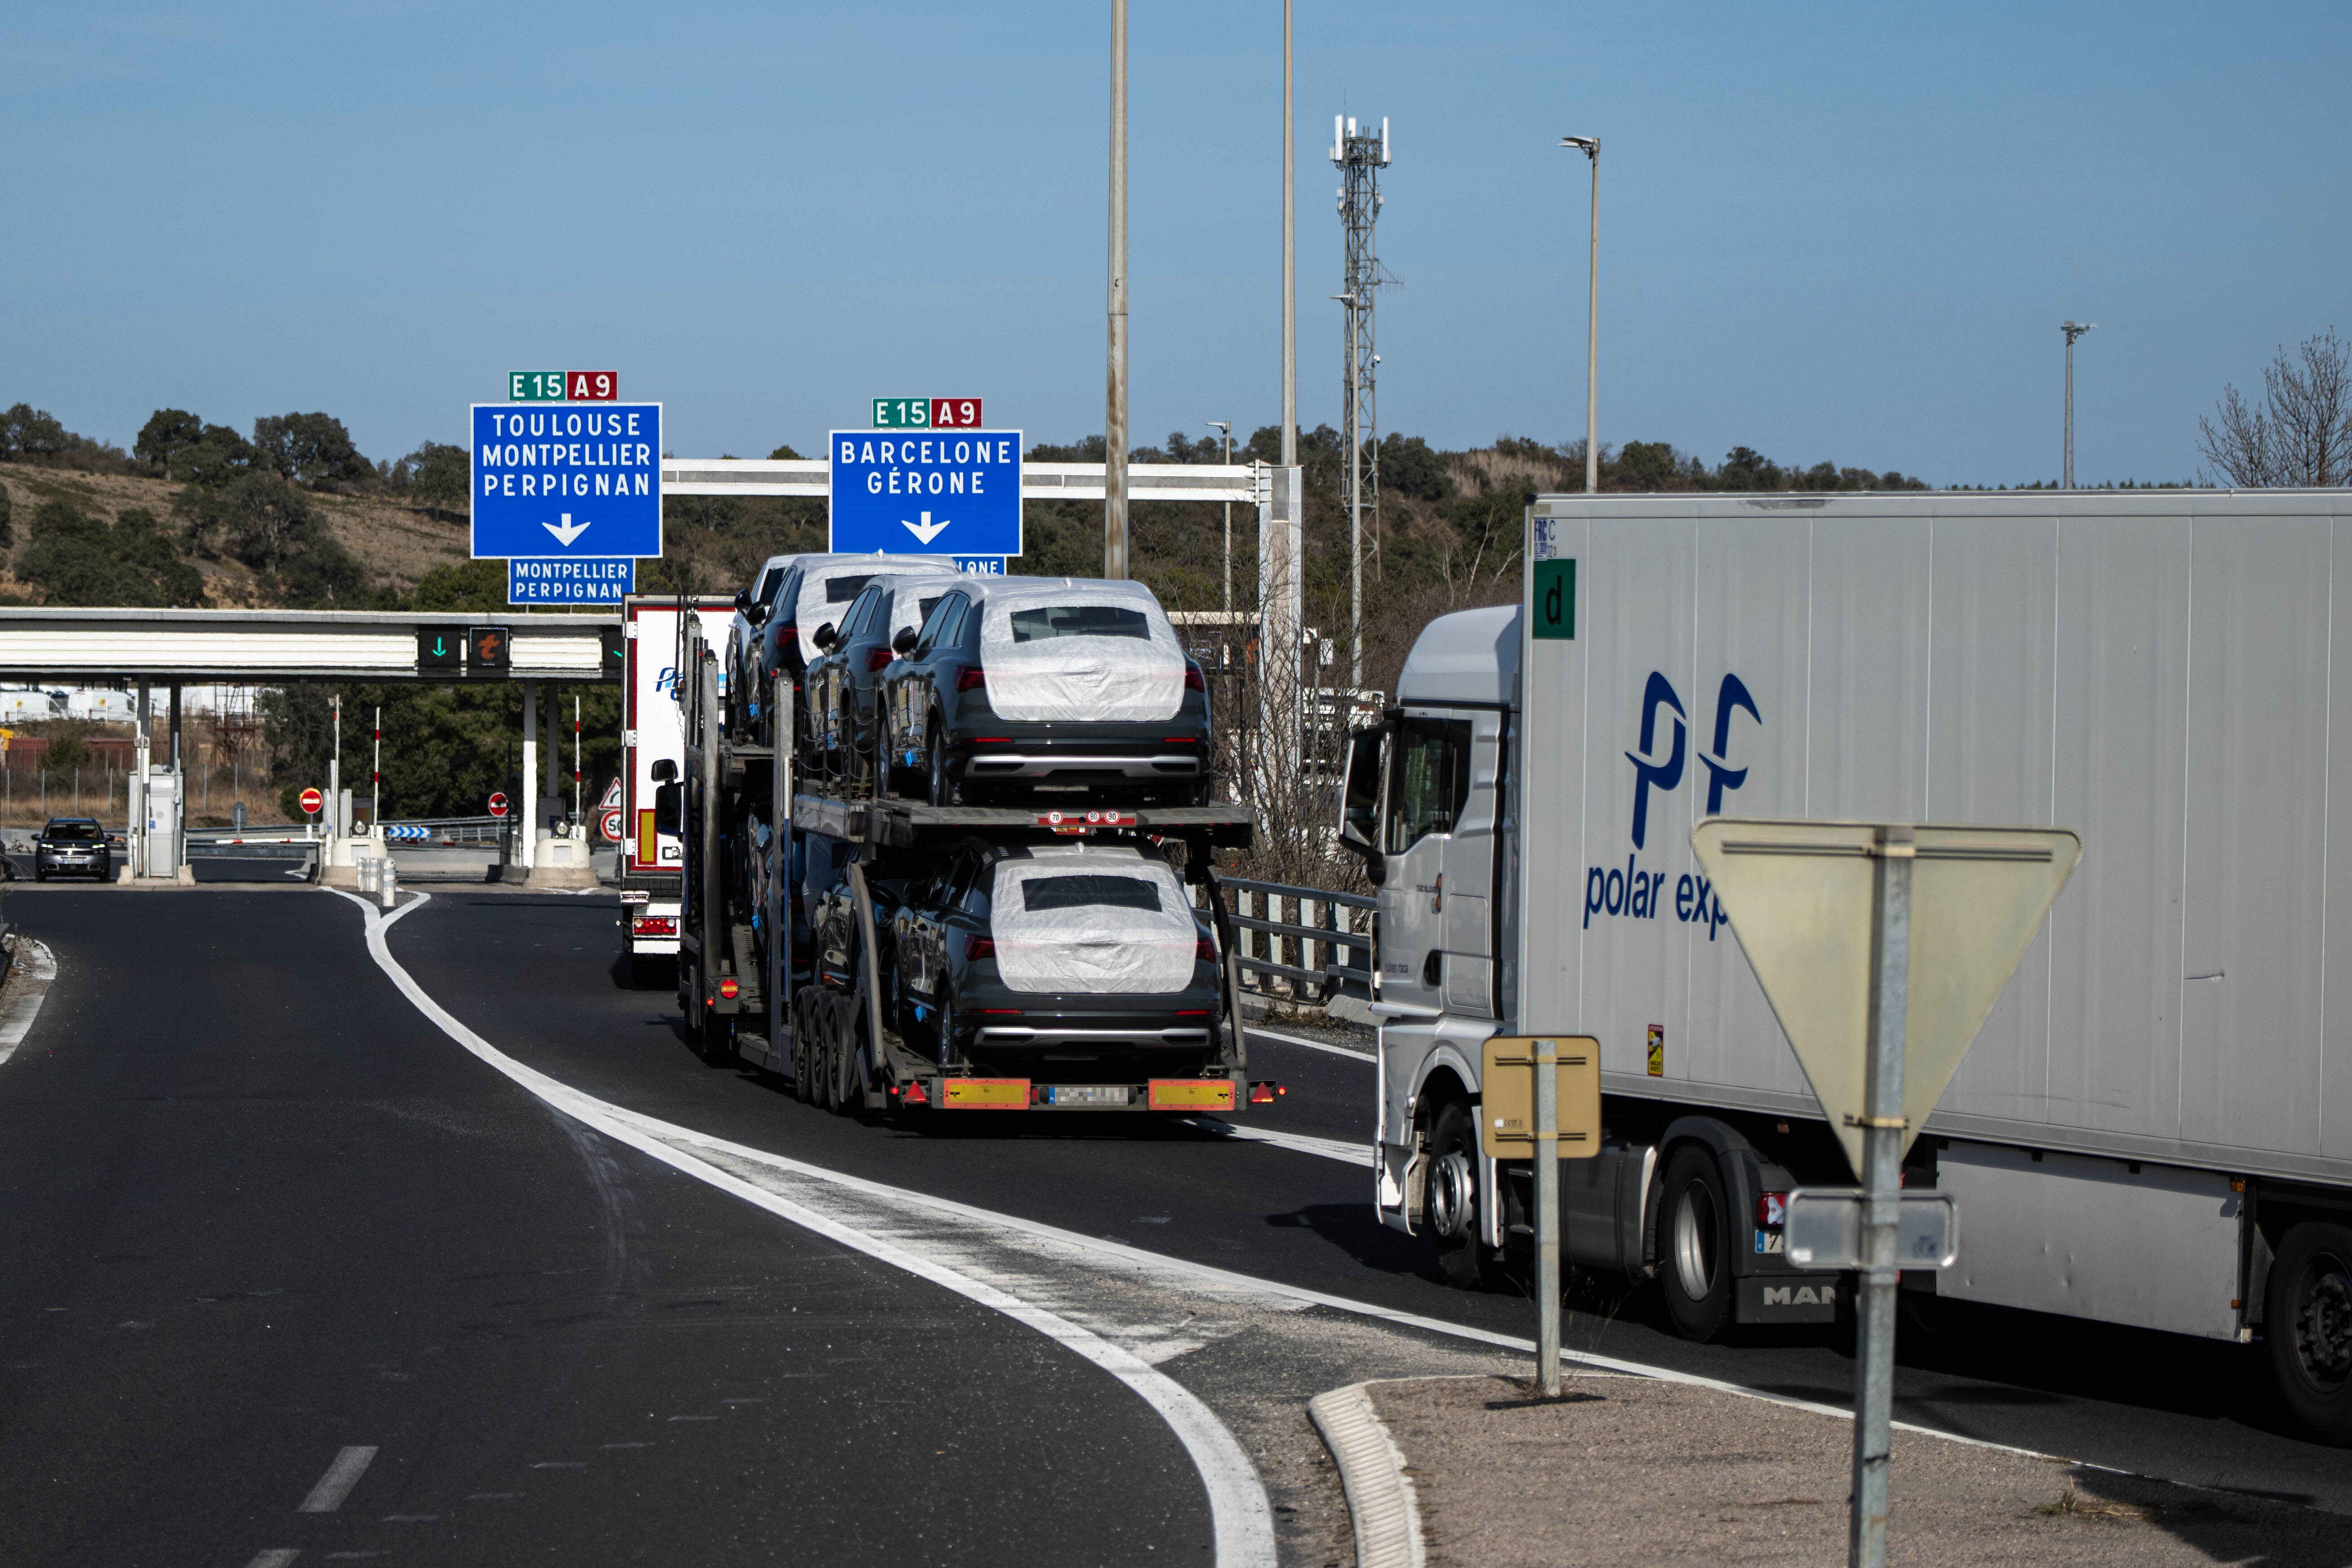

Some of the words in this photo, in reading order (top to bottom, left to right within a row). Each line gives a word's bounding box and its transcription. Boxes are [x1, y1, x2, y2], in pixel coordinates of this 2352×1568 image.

[493, 413, 640, 436] TOULOUSE
[483, 444, 650, 466] MONTPELLIER
[842, 441, 1011, 464] BARCELONE
[484, 473, 649, 496] PERPIGNAN
[868, 467, 984, 494] GÉRONE
[516, 563, 628, 579] MONTPELLIER
[516, 582, 622, 598] PERPIGNAN
[1545, 575, 1562, 626] d
[1108, 813, 1116, 821] 90
[1583, 854, 1666, 930] polar
